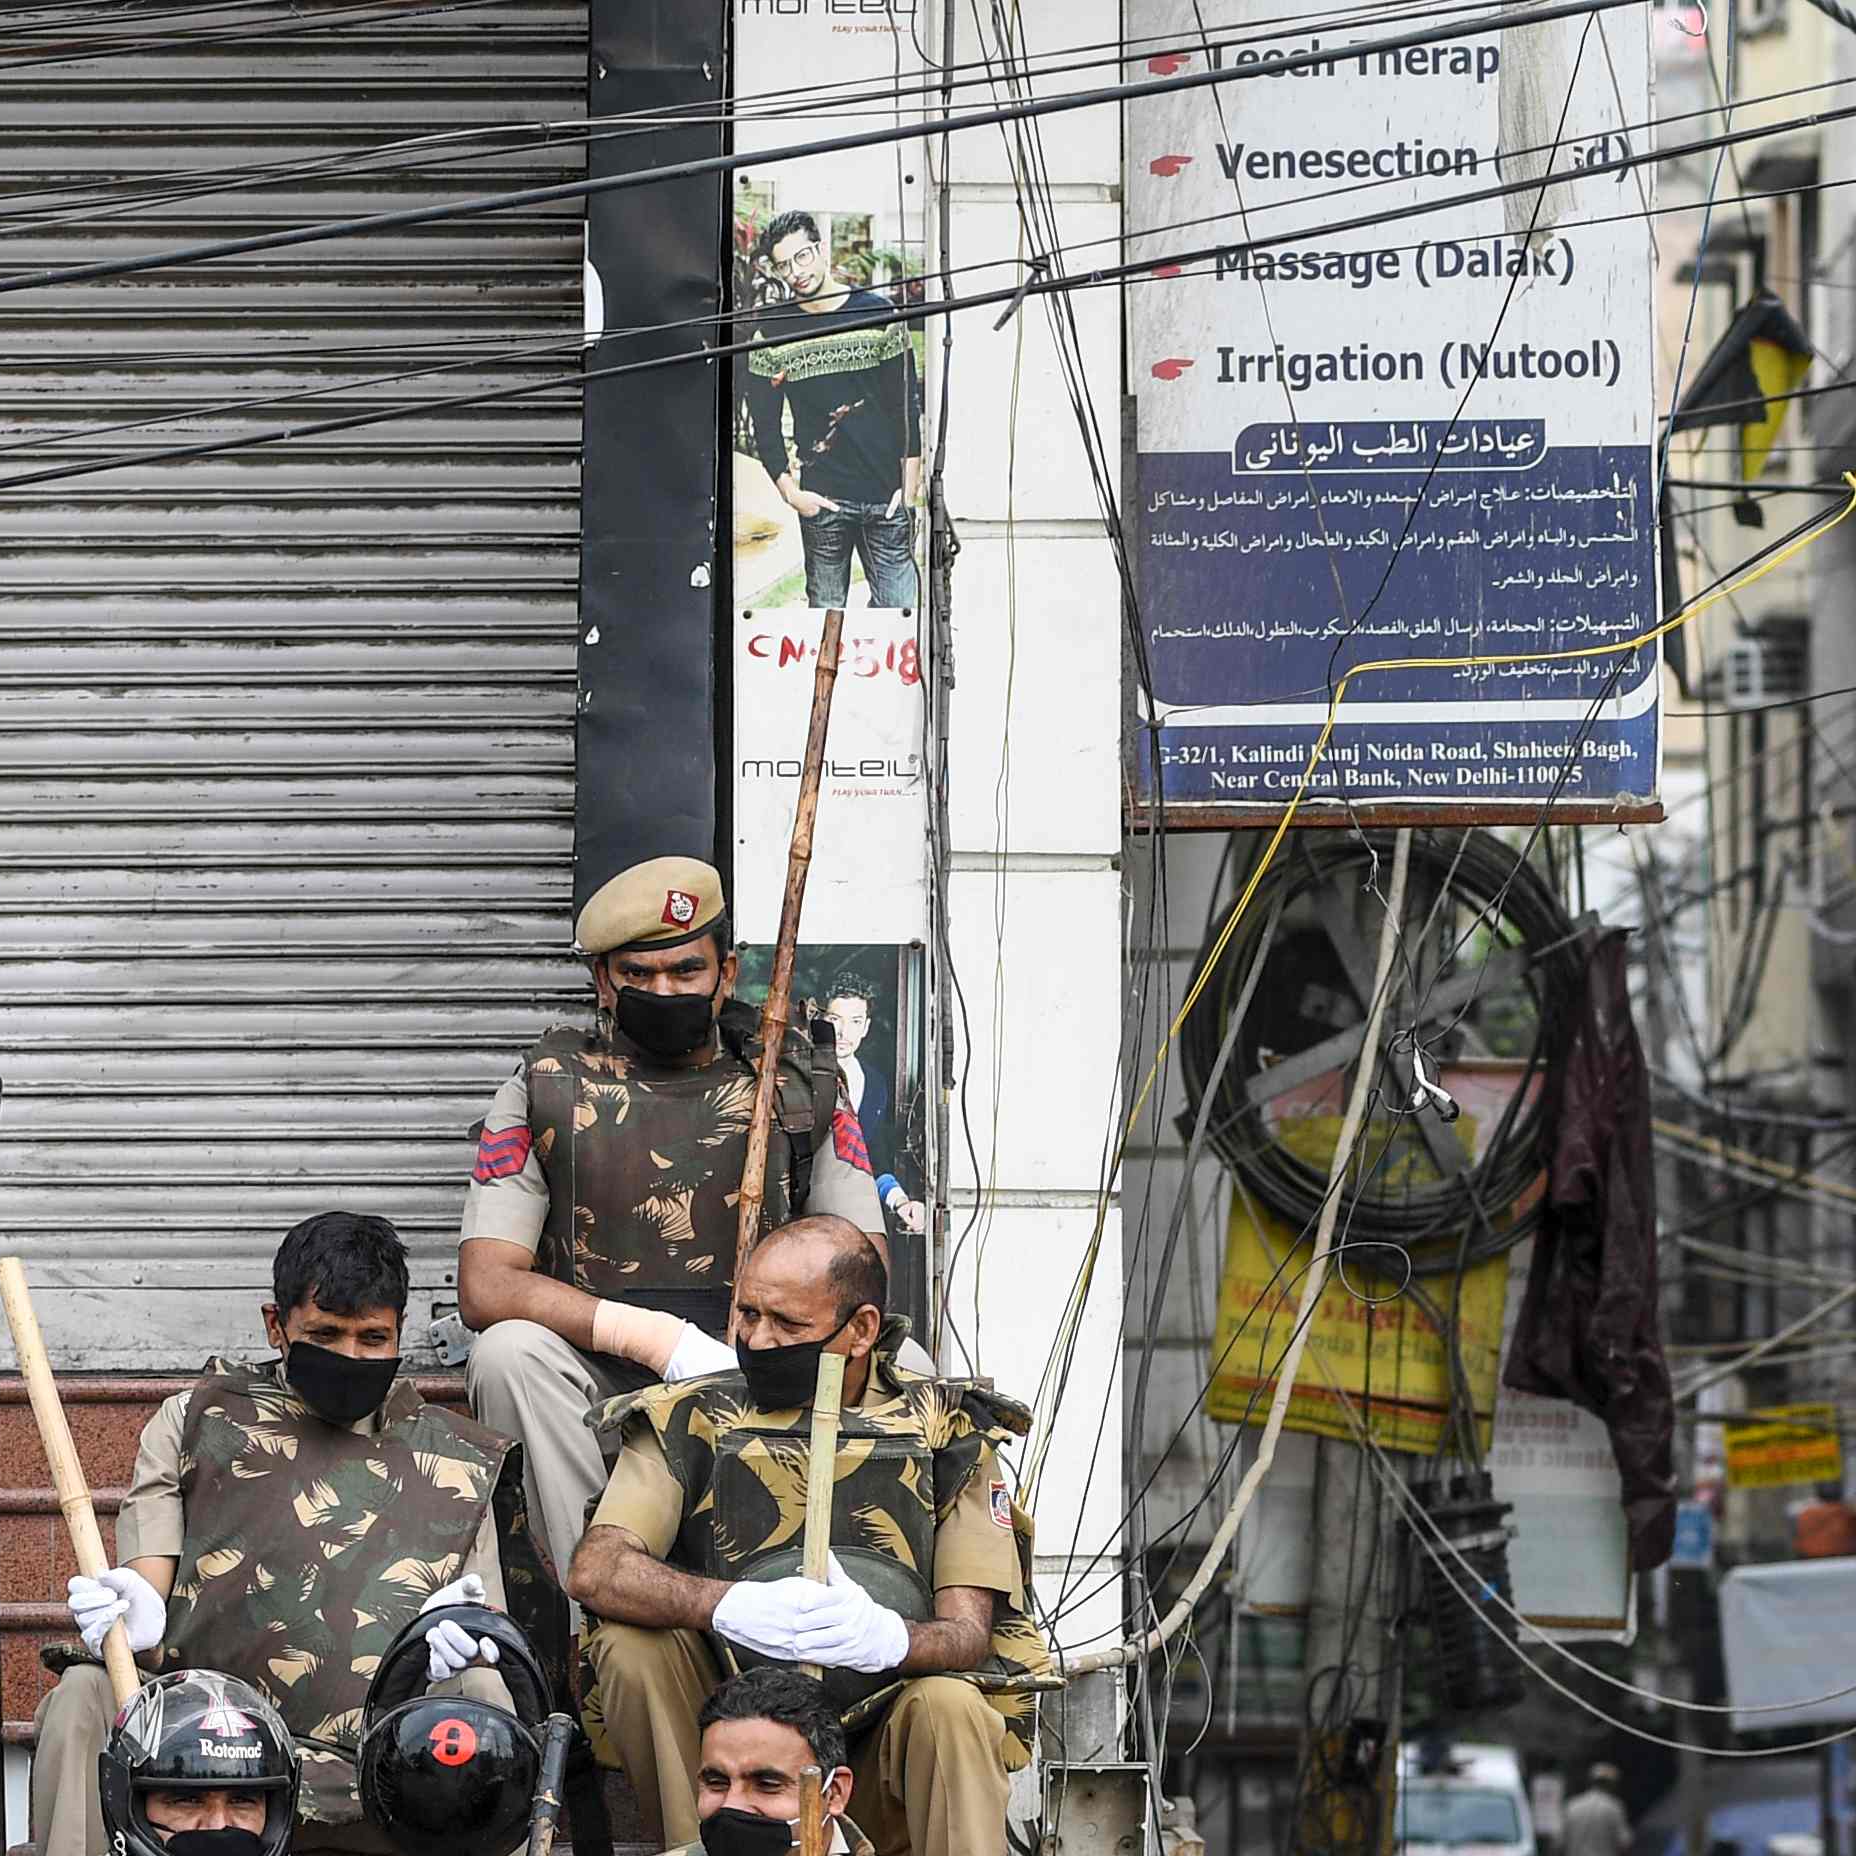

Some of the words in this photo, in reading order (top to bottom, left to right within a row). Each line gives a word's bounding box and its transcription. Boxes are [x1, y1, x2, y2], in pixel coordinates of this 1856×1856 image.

[1215, 139, 1478, 180] Venesection
[1215, 241, 1400, 291] Massage
[1415, 237, 1575, 289] (Dalak)
[1216, 343, 1424, 391] Irrigation
[1441, 339, 1621, 387] (Nutool)
[1351, 424, 1428, 463] الطب
[1438, 425, 1535, 461] عيادات
[1231, 744, 1304, 764] Kalindi
[1366, 743, 1423, 761] Noida
[1431, 742, 1488, 761] Road,
[1582, 740, 1638, 761] Bagh,
[1210, 771, 1258, 789] Near
[1263, 769, 1338, 788] Central
[1344, 768, 1402, 787] Bank,
[1407, 769, 1449, 786] New
[199, 1738, 262, 1760] Rotomac
